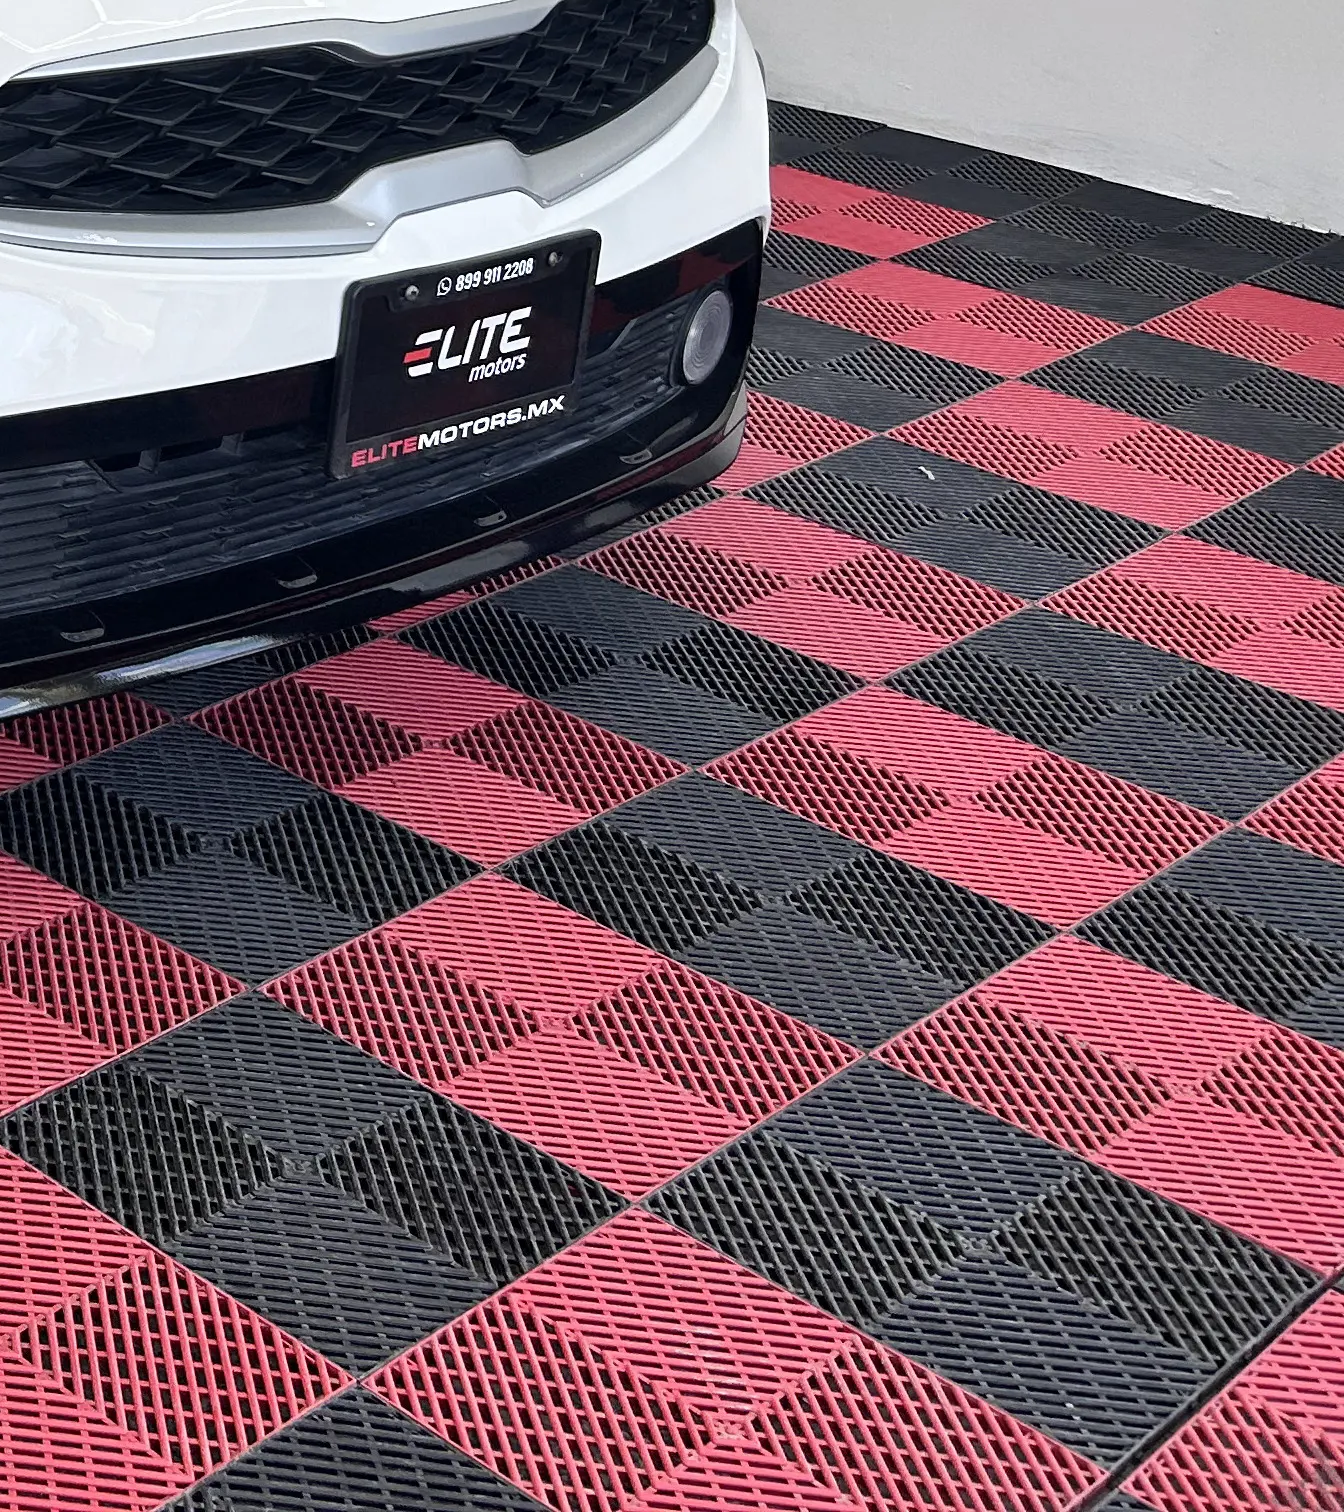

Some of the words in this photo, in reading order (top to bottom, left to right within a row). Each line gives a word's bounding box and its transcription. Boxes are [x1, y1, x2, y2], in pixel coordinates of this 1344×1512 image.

[454, 270, 482, 293] 899
[483, 264, 502, 286] 911
[503, 256, 535, 282] 2208
[402, 305, 534, 378] ELITE
[467, 352, 528, 383] motors
[350, 394, 566, 469] ELITEMOTORS.MX
